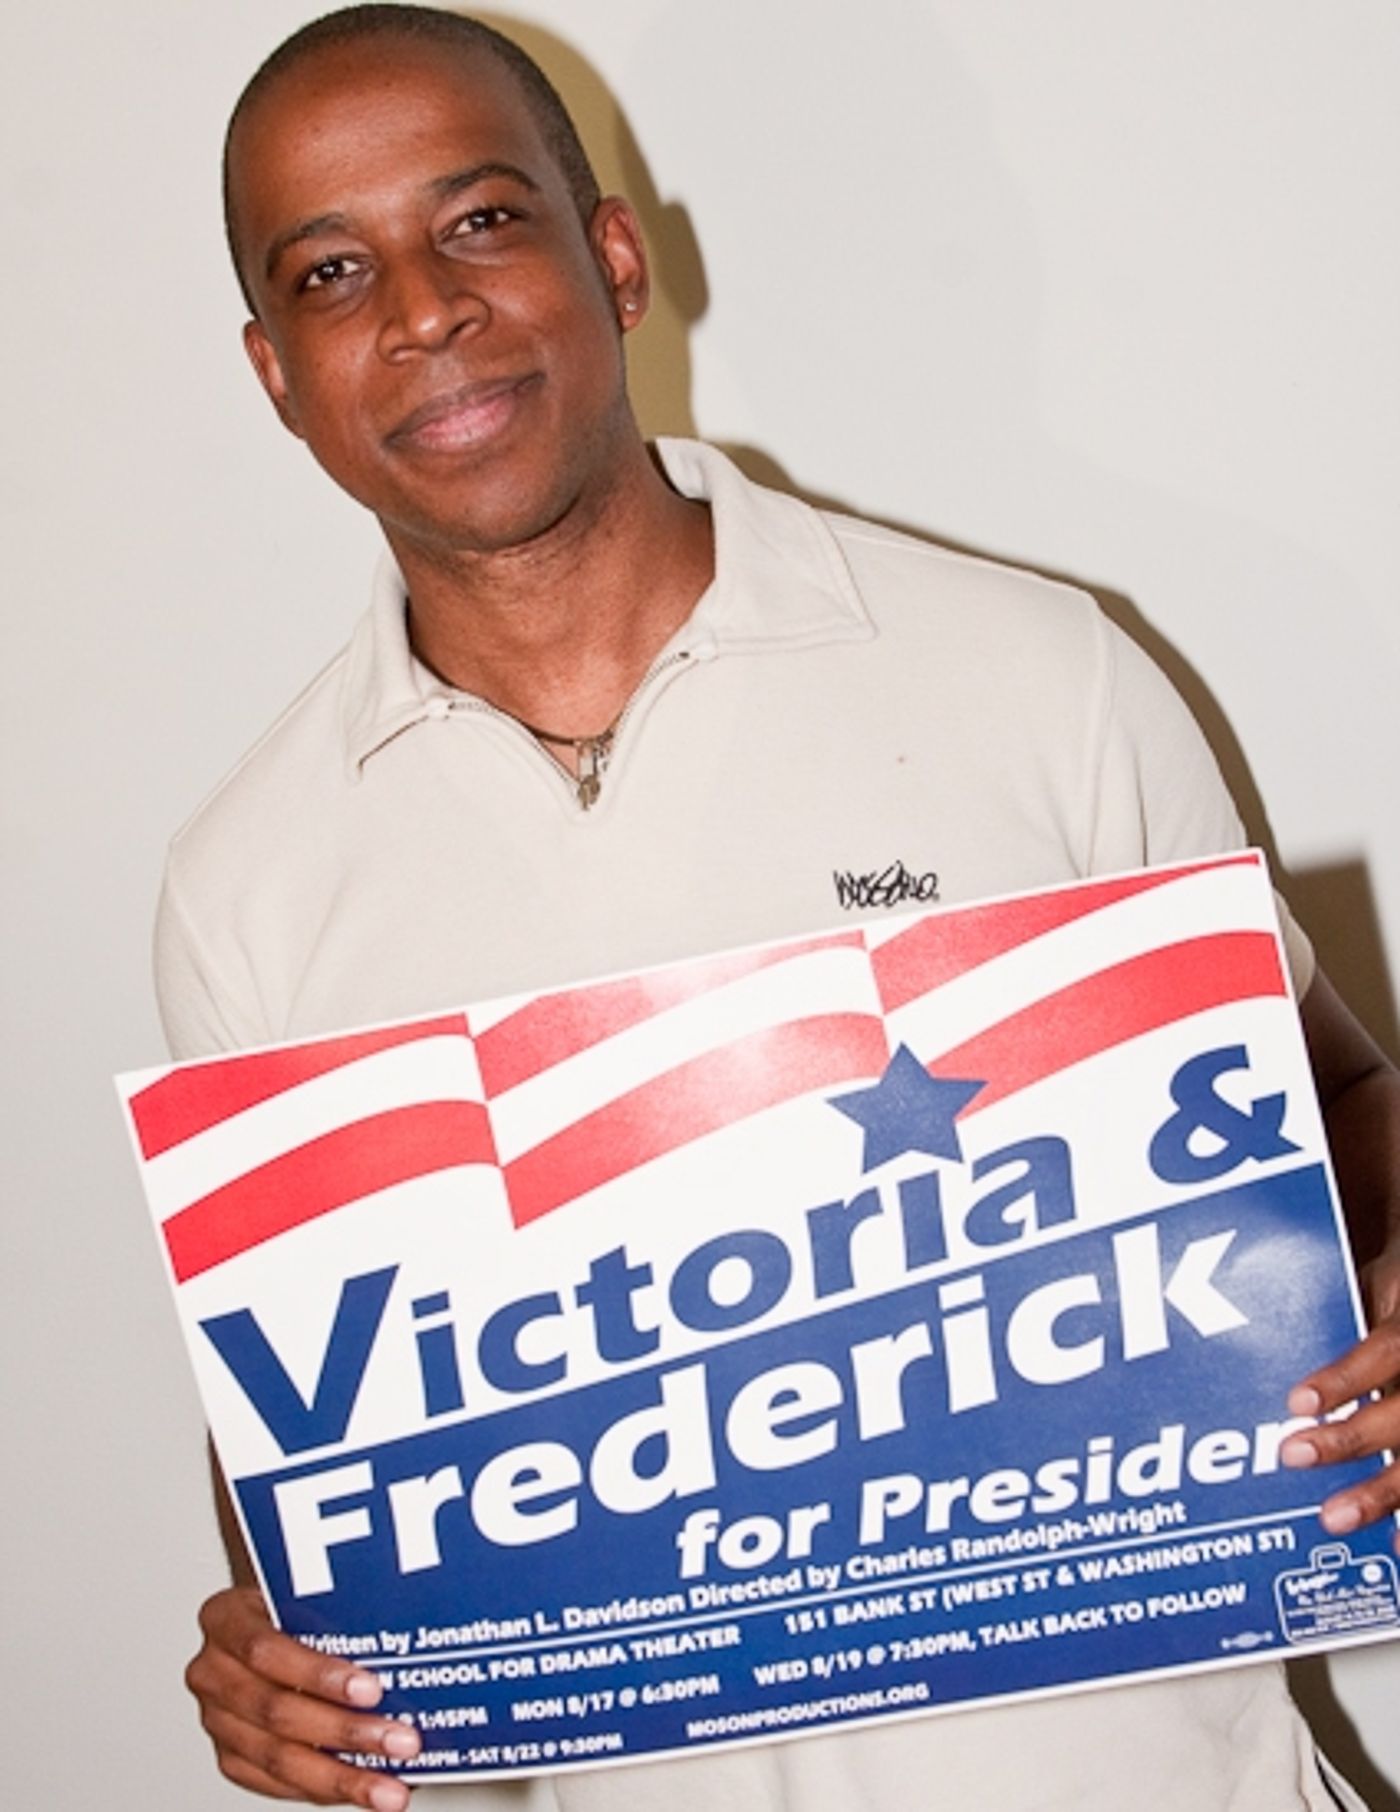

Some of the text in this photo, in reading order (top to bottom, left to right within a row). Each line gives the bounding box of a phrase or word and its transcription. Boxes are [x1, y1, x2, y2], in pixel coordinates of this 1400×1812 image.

[198, 1043, 1304, 1456] Victoria &
[273, 1223, 1249, 1598] Frederick
[380, 1630, 411, 1655] by
[415, 1615, 531, 1649] Jonathan
[534, 1610, 559, 1633] L.
[563, 1590, 685, 1630] Davidson
[689, 1570, 802, 1610] Directed
[808, 1563, 841, 1591] by
[846, 1543, 947, 1580] Charles
[951, 1500, 1187, 1562] Randolph-Wright
[398, 1663, 487, 1689] SCHOOL
[489, 1656, 536, 1682] FOR
[541, 1641, 628, 1675] DRAMA
[629, 1625, 741, 1662] THEATER
[784, 1609, 827, 1636] 151
[833, 1594, 905, 1625] BANK
[908, 1588, 938, 1613] ST
[941, 1575, 1018, 1611] (WEST
[1021, 1568, 1052, 1594] ST
[1055, 1564, 1076, 1588] &
[1078, 1534, 1253, 1584] WASHINGTON
[1257, 1526, 1296, 1552] ST)
[676, 1502, 831, 1579] for
[417, 1706, 488, 1730] 1:45PM
[511, 1697, 564, 1722] MON
[567, 1690, 614, 1718] 8/17
[618, 1686, 637, 1708] @
[641, 1673, 721, 1705] 6:30PM
[753, 1659, 808, 1689] WED
[811, 1647, 863, 1679] 8/19
[866, 1646, 887, 1667] @
[888, 1628, 977, 1663] 7:30PM,
[978, 1618, 1041, 1647] TALK
[1044, 1608, 1108, 1636] BACK
[1111, 1600, 1145, 1625] TO
[1147, 1584, 1247, 1620] FOLLOW
[686, 1682, 930, 1740] MOSONPRODUCTIONS.ORG
[468, 1744, 499, 1765] SAT
[559, 1732, 624, 1756] 9:30PM
